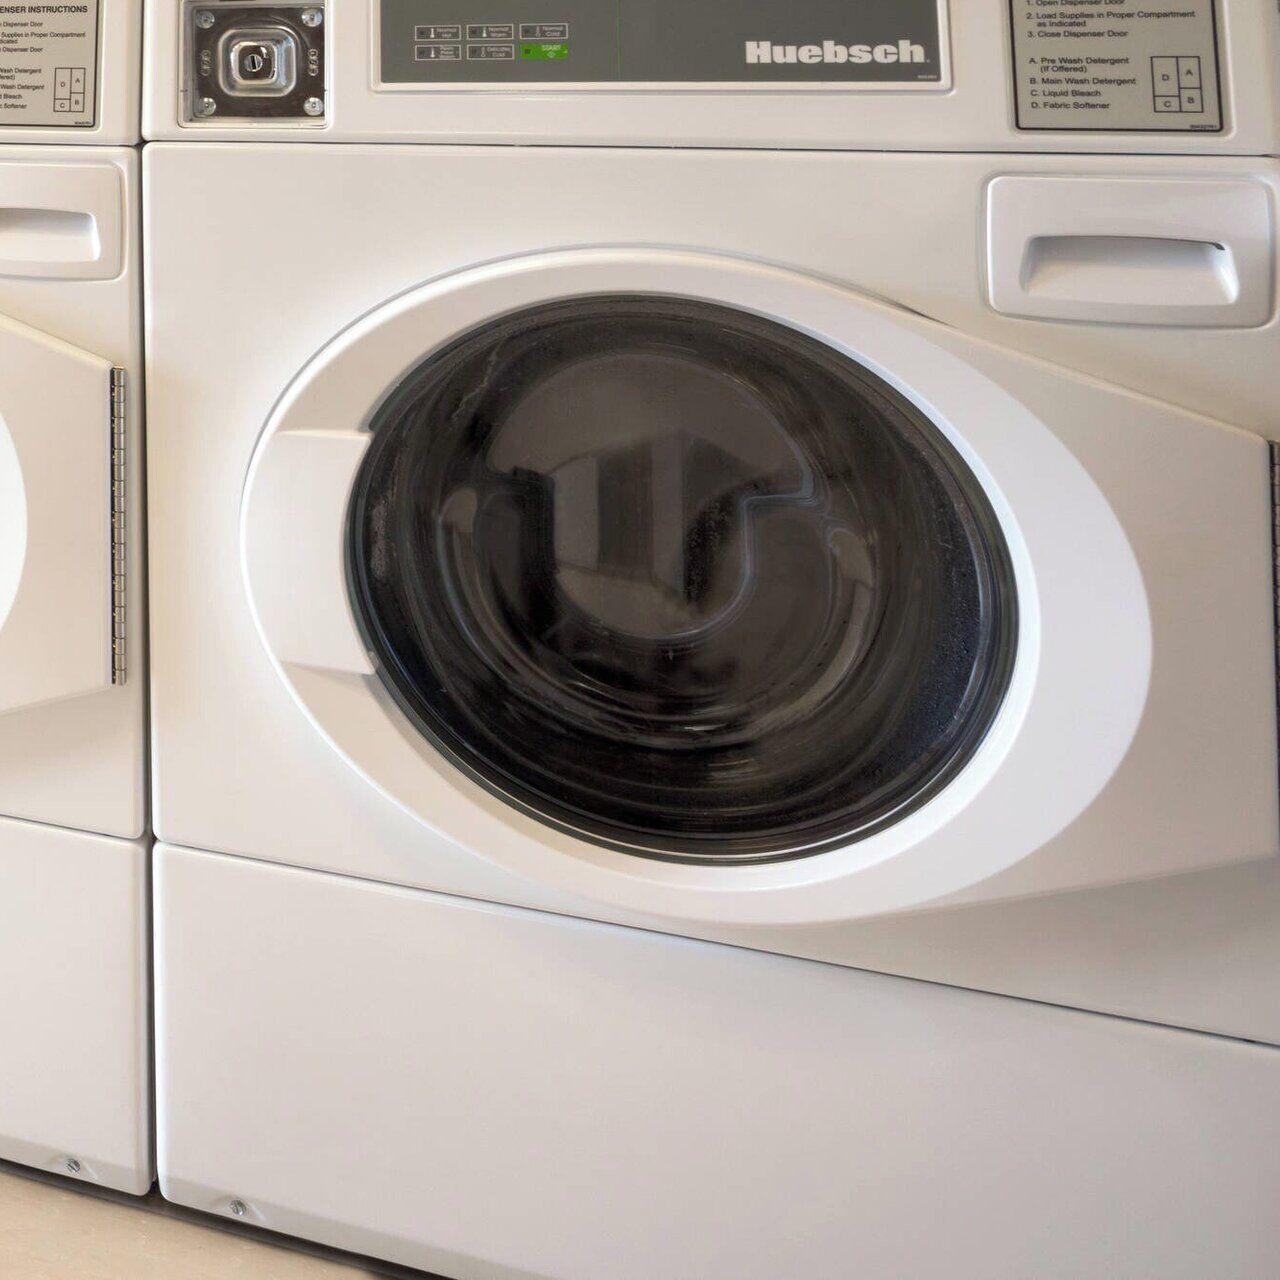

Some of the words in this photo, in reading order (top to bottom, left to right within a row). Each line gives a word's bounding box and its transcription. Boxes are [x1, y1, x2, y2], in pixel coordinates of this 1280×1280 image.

[1035, 0, 1060, 7] Open
[27, 5, 88, 14] INSTRUCTIONS
[1058, 11, 1095, 20] Supplies
[1106, 11, 1136, 20] Proper
[1136, 10, 1196, 20] Compartment
[1063, 30, 1106, 39] Dispenser
[744, 39, 925, 65] Huebsch
[1085, 57, 1130, 66] Detergent
[1050, 65, 1088, 73] Offered)
[1091, 77, 1137, 86] Detergent
[1161, 74, 1170, 82] D
[1042, 90, 1070, 98] Liquid
[1070, 89, 1102, 97] Bleach
[1187, 96, 1195, 104] B
